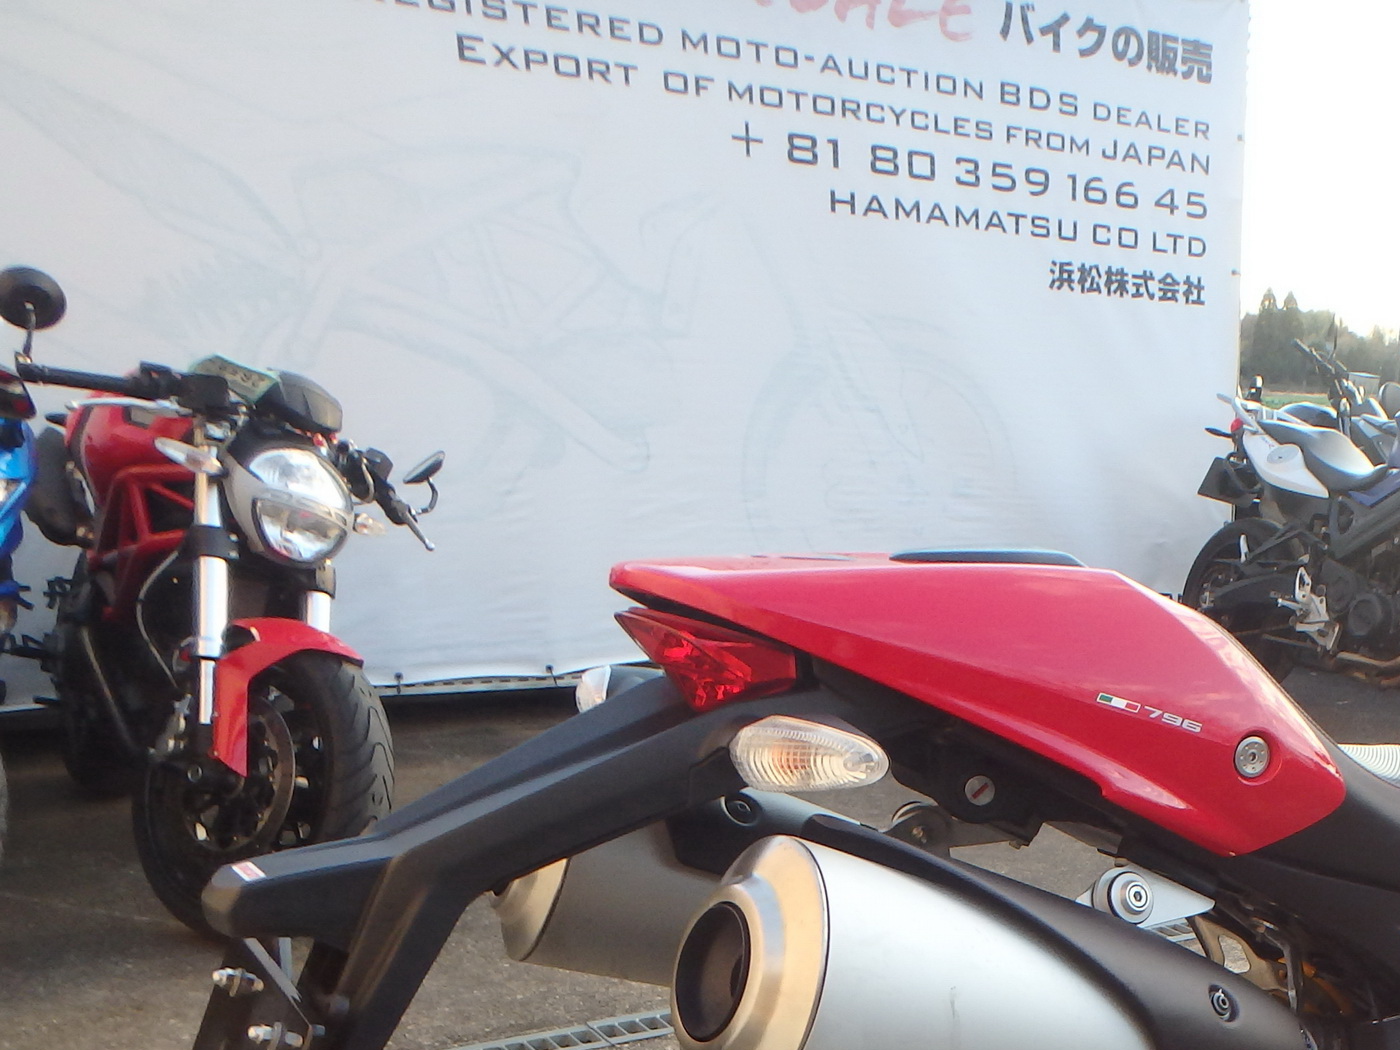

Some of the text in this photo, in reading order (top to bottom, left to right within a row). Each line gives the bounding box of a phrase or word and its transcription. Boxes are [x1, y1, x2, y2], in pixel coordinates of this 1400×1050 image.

[376, 0, 1210, 140] GISTERED MOTO-AUCTION BDS DEALER
[1000, 2, 1214, 84] バイクの販売
[663, 70, 714, 97] OF
[728, 80, 993, 141] MOTORCYCLES
[1006, 125, 1090, 157] FROM
[1102, 139, 1210, 176] JAPAN
[787, 132, 839, 169] 81
[870, 143, 936, 182] 80
[955, 157, 1050, 196] 359
[1066, 173, 1140, 210] 166
[1154, 188, 1208, 220] 45
[829, 190, 1207, 258] HAMAMATSU CO LTD
[1049, 260, 1206, 306] 浜松株式会社
[1144, 705, 1202, 733] 796
